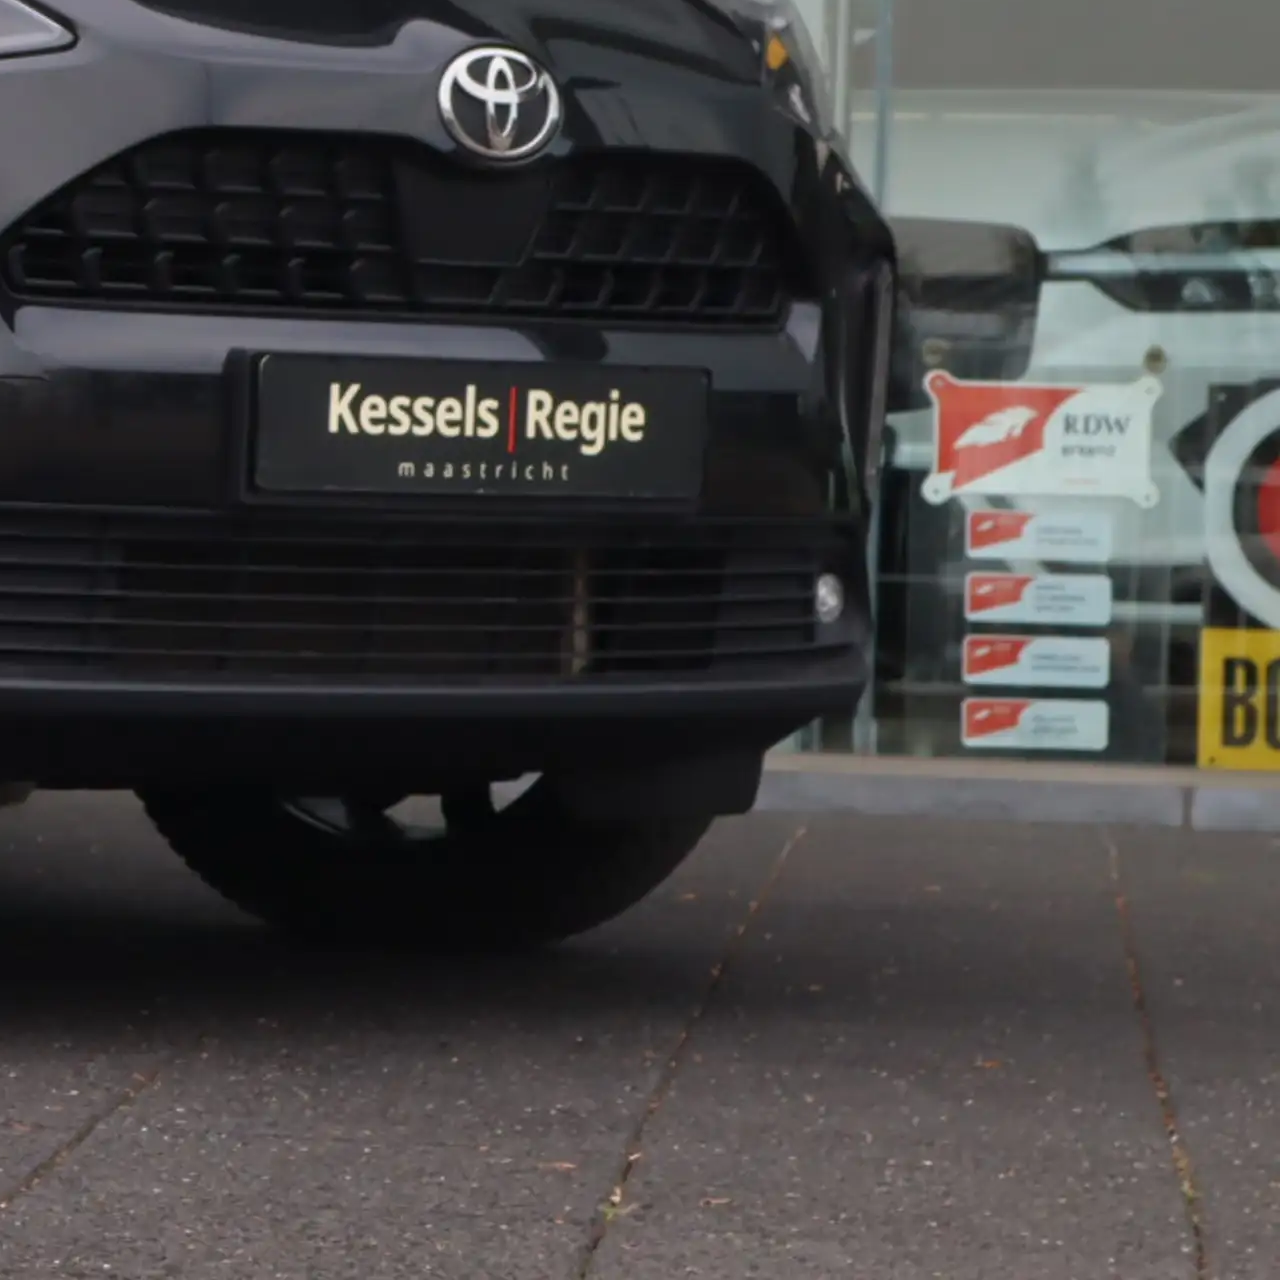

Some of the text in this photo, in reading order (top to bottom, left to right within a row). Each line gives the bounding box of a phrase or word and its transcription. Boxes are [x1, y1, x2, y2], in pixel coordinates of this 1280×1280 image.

[327, 382, 647, 457] Kessels Regie
[1062, 412, 1131, 435] RDW
[397, 460, 570, 482] maastricht
